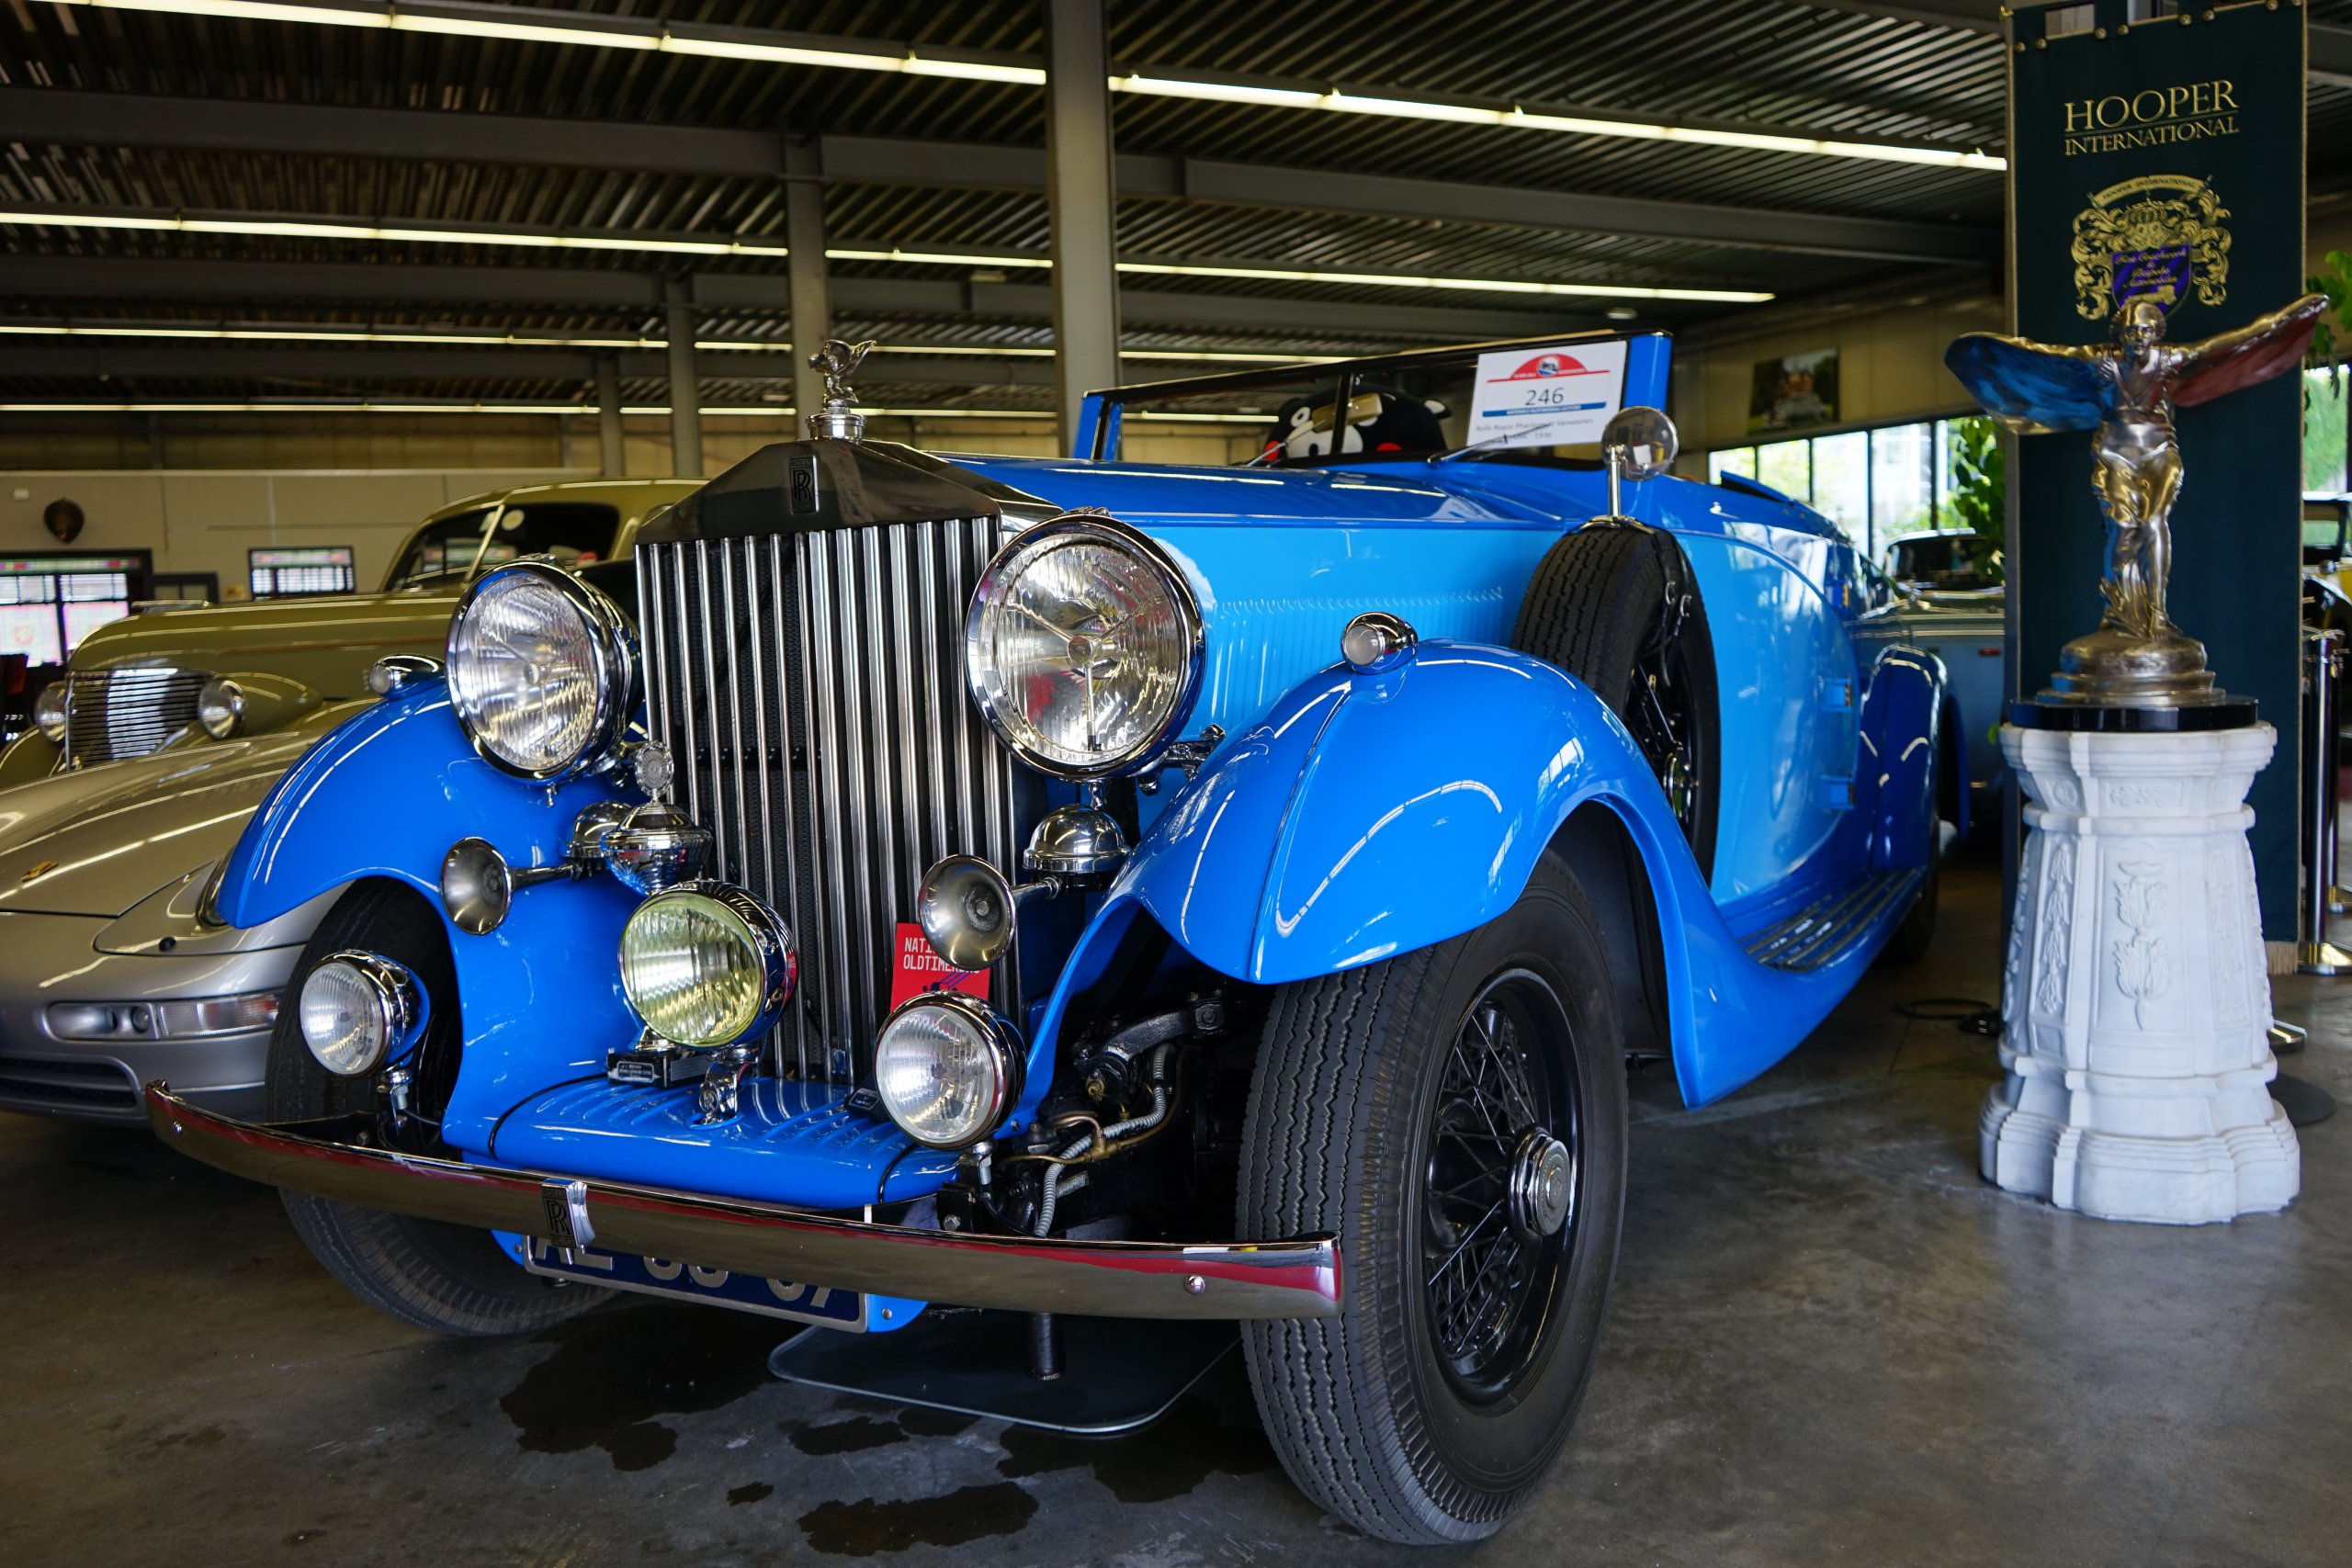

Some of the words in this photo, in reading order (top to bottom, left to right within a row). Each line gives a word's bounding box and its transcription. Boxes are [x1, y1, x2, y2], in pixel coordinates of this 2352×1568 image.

[2064, 80, 2240, 132] HOOPER
[2064, 116, 2240, 156] INTERNATIONAL
[1525, 388, 1564, 405] 246
[905, 938, 934, 953] NATI
[543, 1190, 565, 1198] ROLLS
